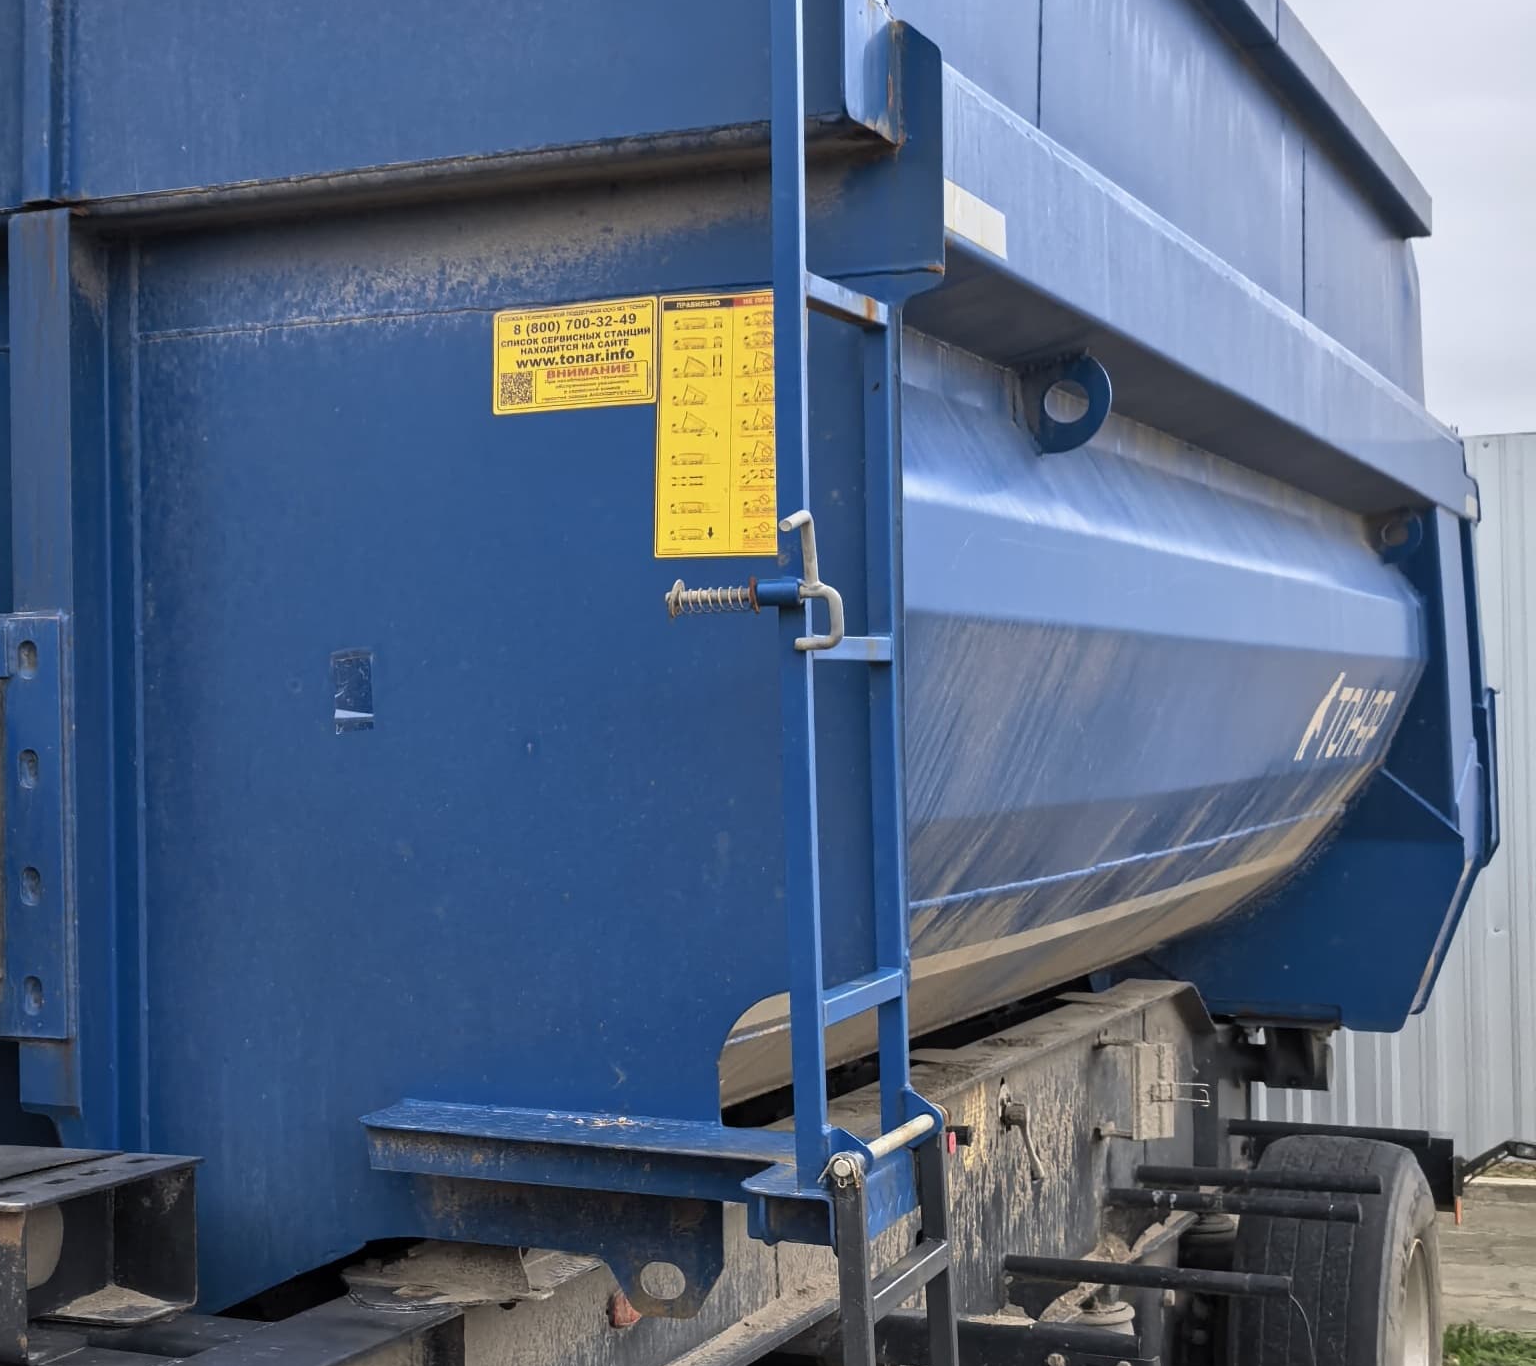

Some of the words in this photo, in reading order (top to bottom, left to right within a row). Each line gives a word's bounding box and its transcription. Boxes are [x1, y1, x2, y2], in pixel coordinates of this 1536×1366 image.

[676, 299, 720, 309] ПРАВИЛЬНО
[513, 324, 521, 335] 8
[526, 320, 561, 337] (800)
[566, 313, 637, 331] 700-32-49
[500, 337, 539, 348] СПИСОК
[541, 332, 601, 345] СЕРВИСНЫХ
[604, 326, 651, 338] СТАНЦИЙ
[520, 343, 578, 356] НАХОДИТСЯ
[581, 341, 595, 350] НА
[597, 338, 629, 349] САЙТЕ
[516, 349, 635, 369] www.tonar.info
